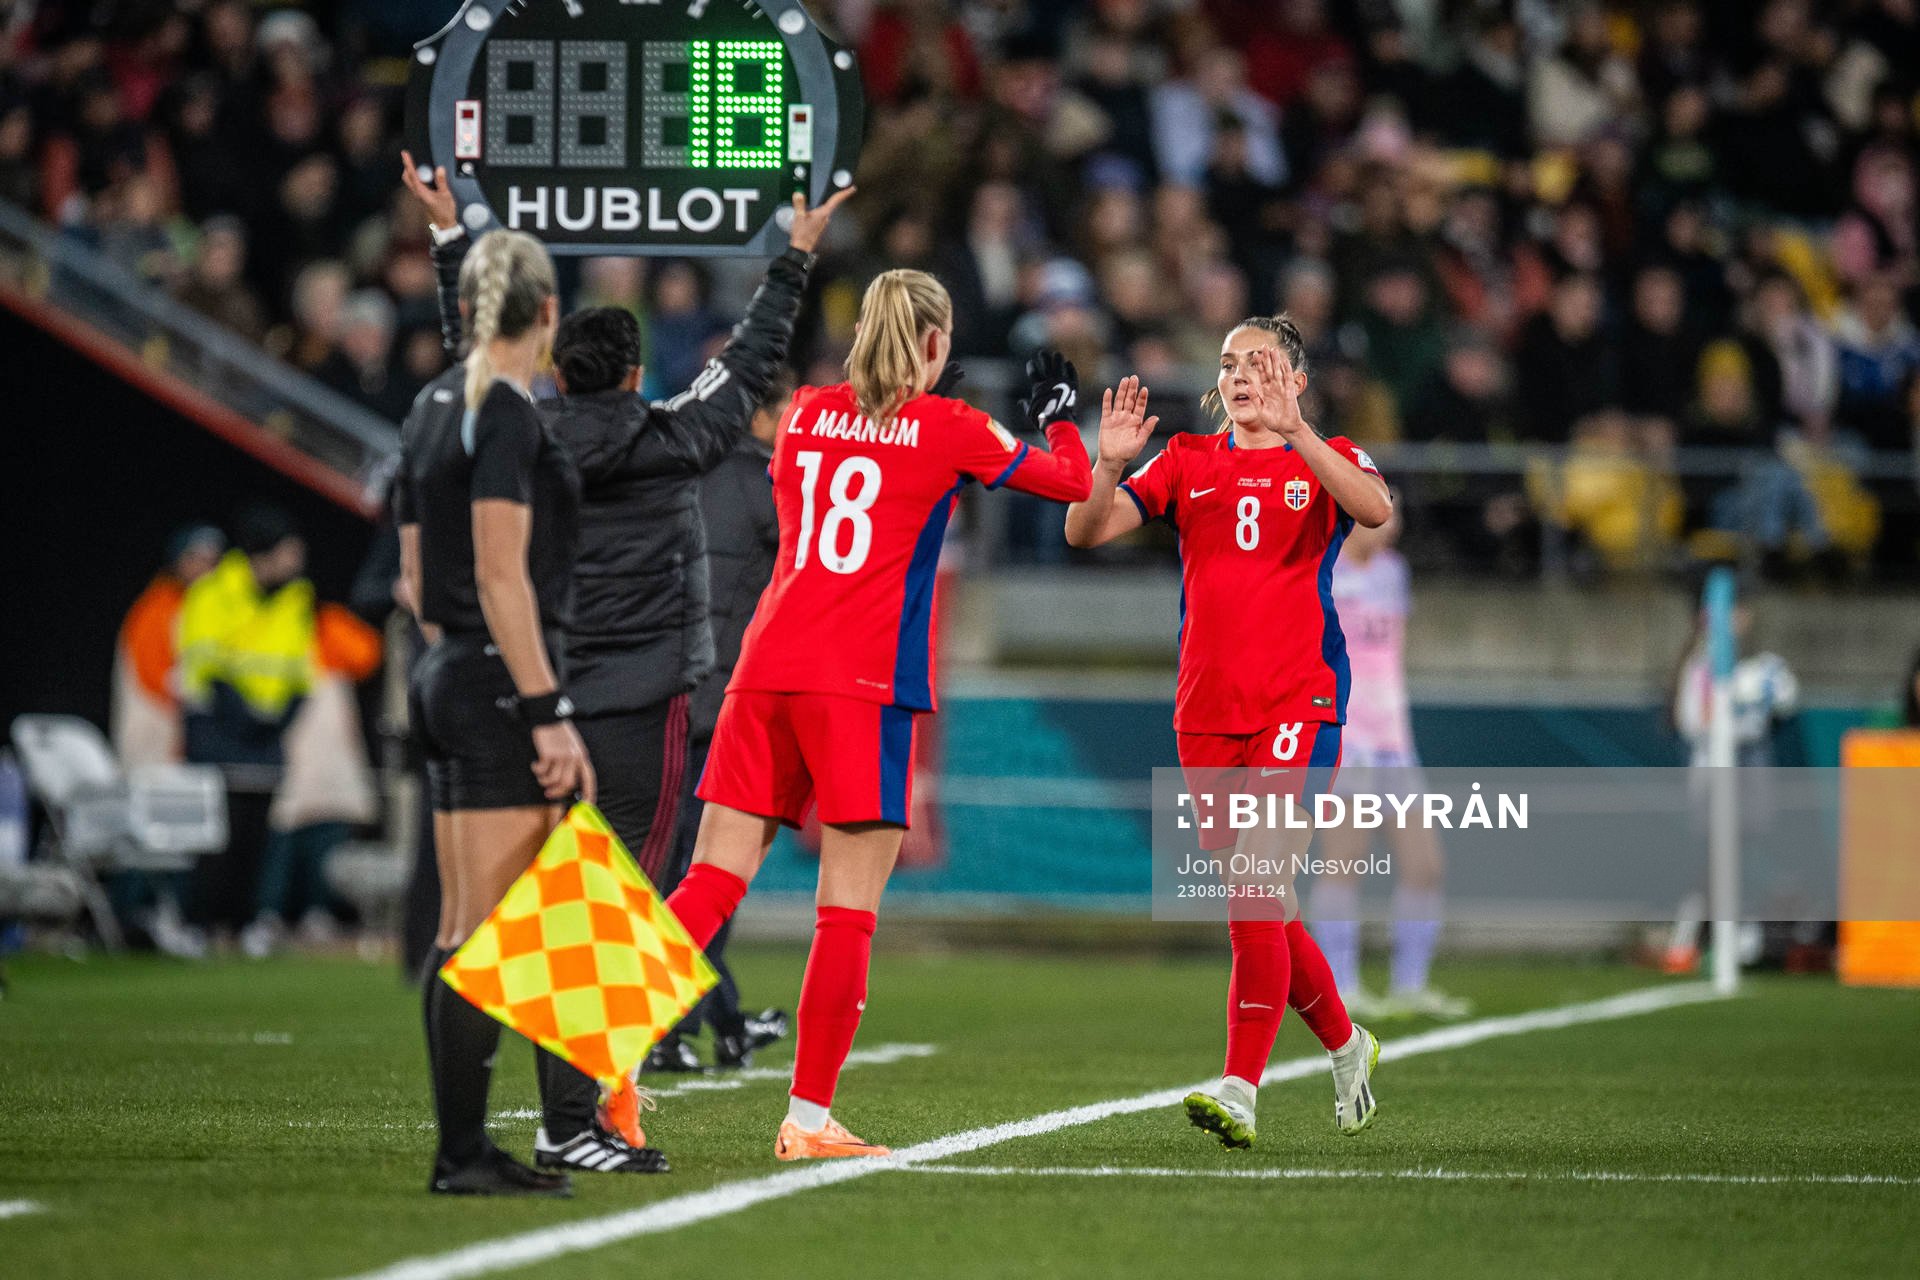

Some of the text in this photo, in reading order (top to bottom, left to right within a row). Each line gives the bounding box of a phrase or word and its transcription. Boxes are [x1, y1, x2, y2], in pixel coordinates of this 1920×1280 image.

[691, 40, 783, 168] 18
[508, 186, 760, 232] HUBLOT
[788, 407, 920, 448] L. MAANUM
[795, 450, 882, 574] 18
[1235, 495, 1261, 551] 8
[1272, 721, 1304, 761] 8
